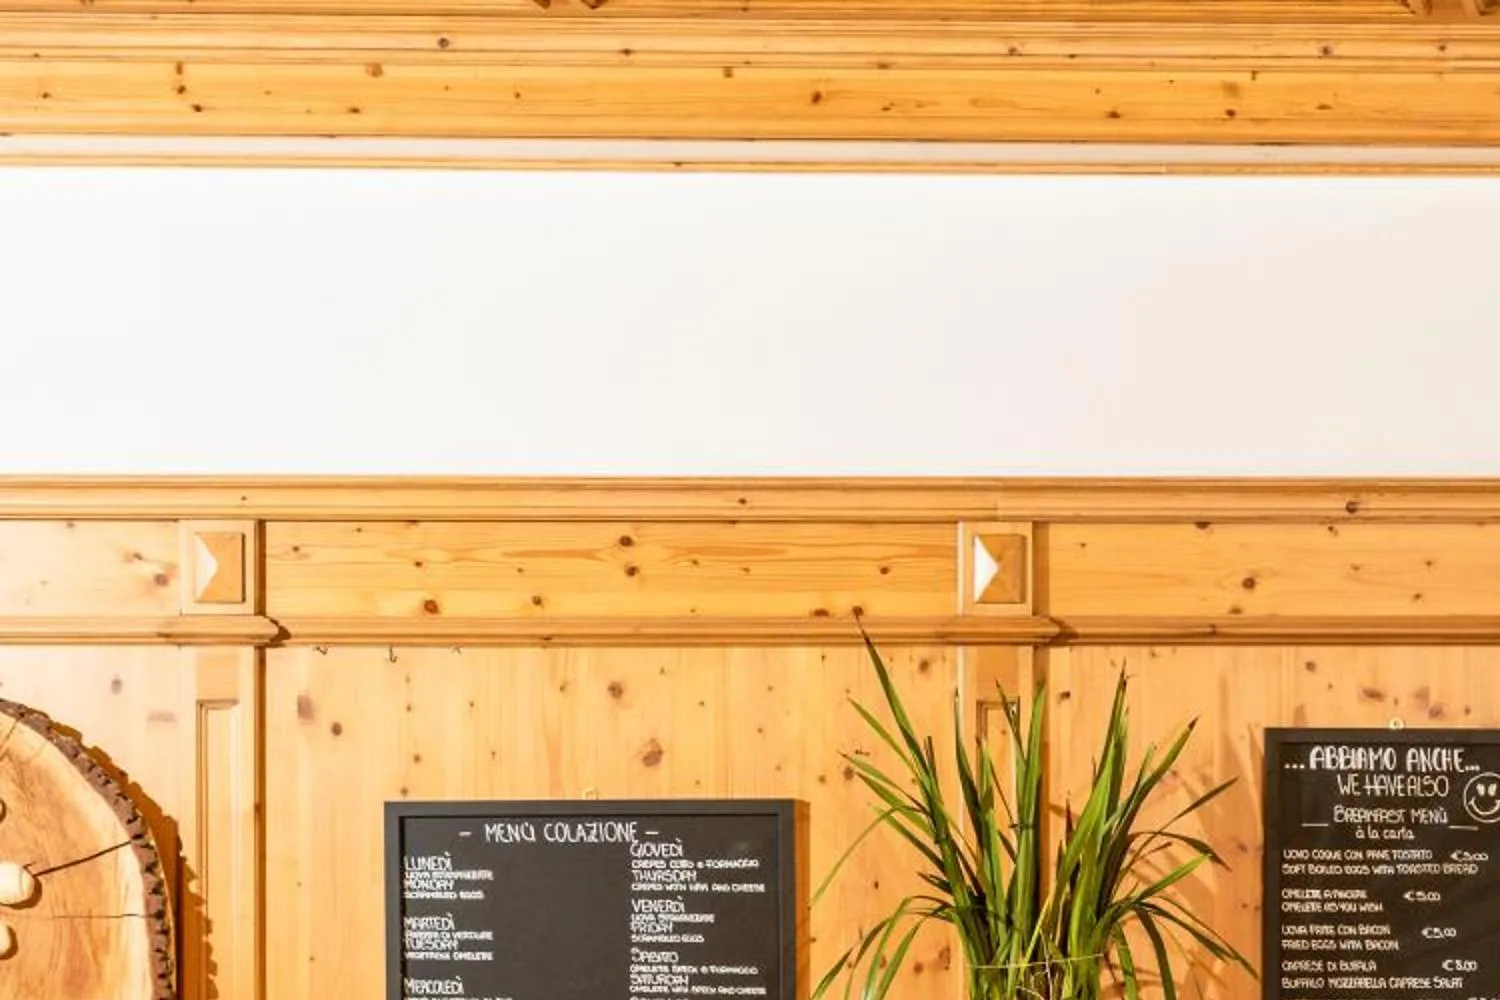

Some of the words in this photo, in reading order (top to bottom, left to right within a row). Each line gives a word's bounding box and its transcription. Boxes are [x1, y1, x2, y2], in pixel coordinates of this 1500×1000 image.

[1337, 773, 1361, 796] WE
[1363, 774, 1405, 797] HAVE
[1408, 775, 1450, 797] ALSO
[1333, 804, 1406, 824] BREAKFAST
[1411, 806, 1449, 825] MENÙ
[543, 821, 638, 843] COLAZIONE
[630, 838, 683, 858] GIOVEDÌ
[1283, 849, 1310, 860] UOVO
[1343, 849, 1363, 860] CON
[403, 851, 453, 871] LUNEDÌ
[631, 869, 697, 882] THURSDAY
[1281, 863, 1306, 875] SOFT
[1307, 863, 1343, 875] BOILED
[1343, 864, 1371, 875] EGGS
[1371, 864, 1395, 875] WITH
[1395, 863, 1441, 875] TOASTED
[1442, 863, 1479, 875] BREAD
[403, 878, 454, 891] MONDAY
[631, 895, 685, 913] VENERDÌ
[403, 912, 455, 930] MARTEDÌ
[630, 921, 673, 933] FRIDAY
[1281, 924, 1307, 935] UOVA
[1337, 924, 1357, 935] CON
[1357, 923, 1391, 935] BACON
[404, 938, 459, 951] TUESDAY
[1281, 939, 1310, 951] FRIED
[1311, 939, 1337, 951] EGGS
[1364, 939, 1399, 951] BACON
[630, 947, 679, 963] SABATO
[403, 975, 465, 994] MERCOLEDÌ
[630, 973, 689, 985] SATURDAY
[1281, 977, 1325, 989] BUFFALO
[1327, 977, 1387, 989] MOZZARELLA
[1388, 977, 1432, 989] CAPRESE
